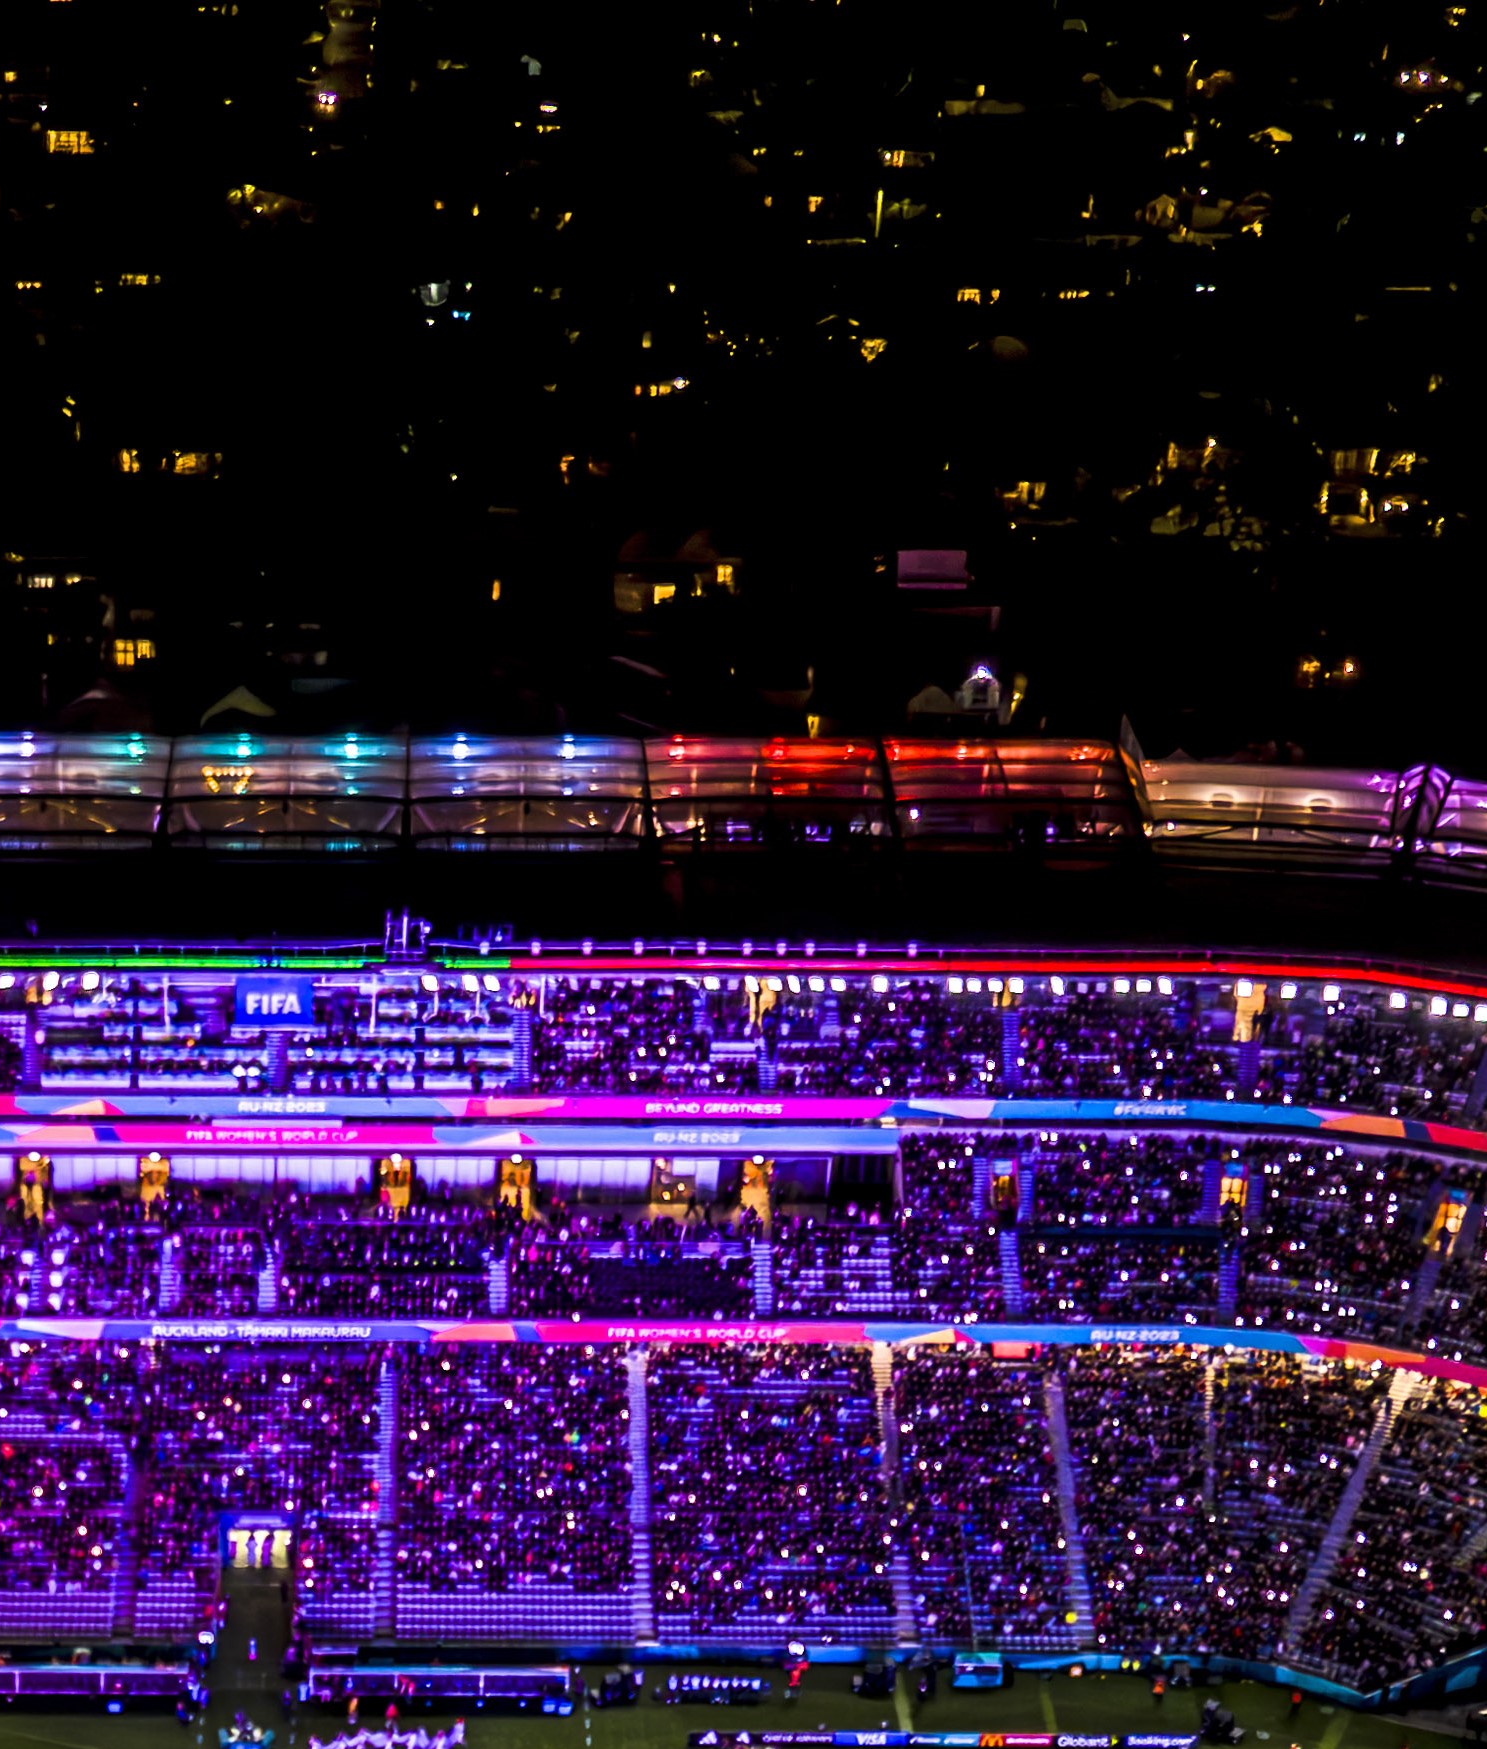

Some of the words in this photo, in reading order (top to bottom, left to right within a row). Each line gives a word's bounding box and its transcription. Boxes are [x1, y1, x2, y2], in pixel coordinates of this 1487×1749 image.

[246, 992, 301, 1015] FIFA
[703, 1103, 783, 1114] GREATNESS
[186, 1131, 212, 1141] FIFA
[332, 1131, 358, 1141] CUP
[151, 1325, 228, 1337] AUCKLAND
[291, 1326, 371, 1338] MAKAURAU
[608, 1327, 635, 1338] FIFA
[706, 1328, 754, 1338] WORLD
[757, 1328, 786, 1338] CUP
[856, 1733, 886, 1746] VISA
[1057, 1735, 1109, 1748] Globant
